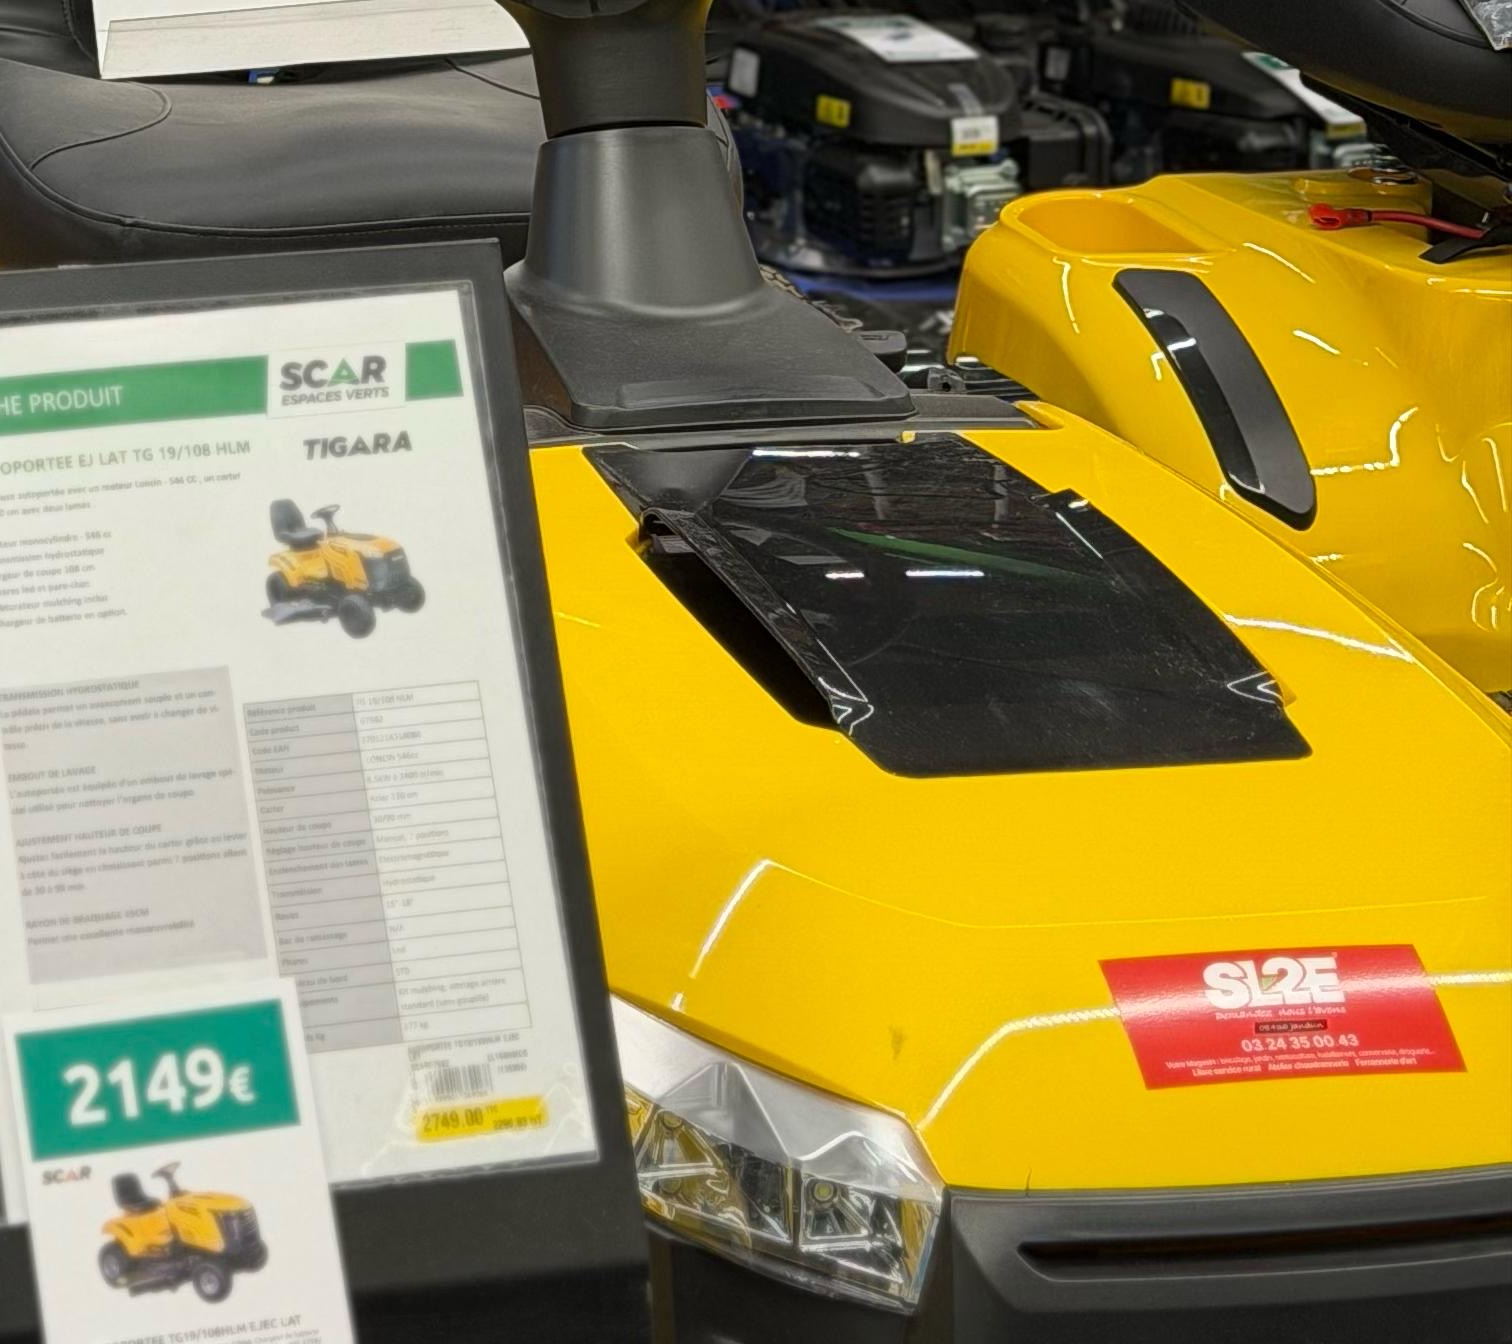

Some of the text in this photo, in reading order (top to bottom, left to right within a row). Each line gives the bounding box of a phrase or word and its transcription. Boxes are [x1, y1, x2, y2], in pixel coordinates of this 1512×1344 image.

[279, 355, 387, 391] SCAR
[29, 386, 124, 413] PRODUIT
[281, 386, 390, 406] ESPACES VERTS
[78, 453, 93, 468] EJ
[98, 450, 127, 466] LAT
[134, 448, 153, 463] TG
[158, 443, 210, 460] 19/108
[215, 439, 250, 455] HLM
[303, 430, 413, 460] TIGARA
[1202, 956, 1345, 1010] SL2E
[62, 1048, 256, 1126] 2149€
[421, 1107, 483, 1132] 2749.00
[42, 1165, 92, 1185] SCAR
[249, 1317, 279, 1333] EJEC
[280, 1314, 303, 1328] LAT
